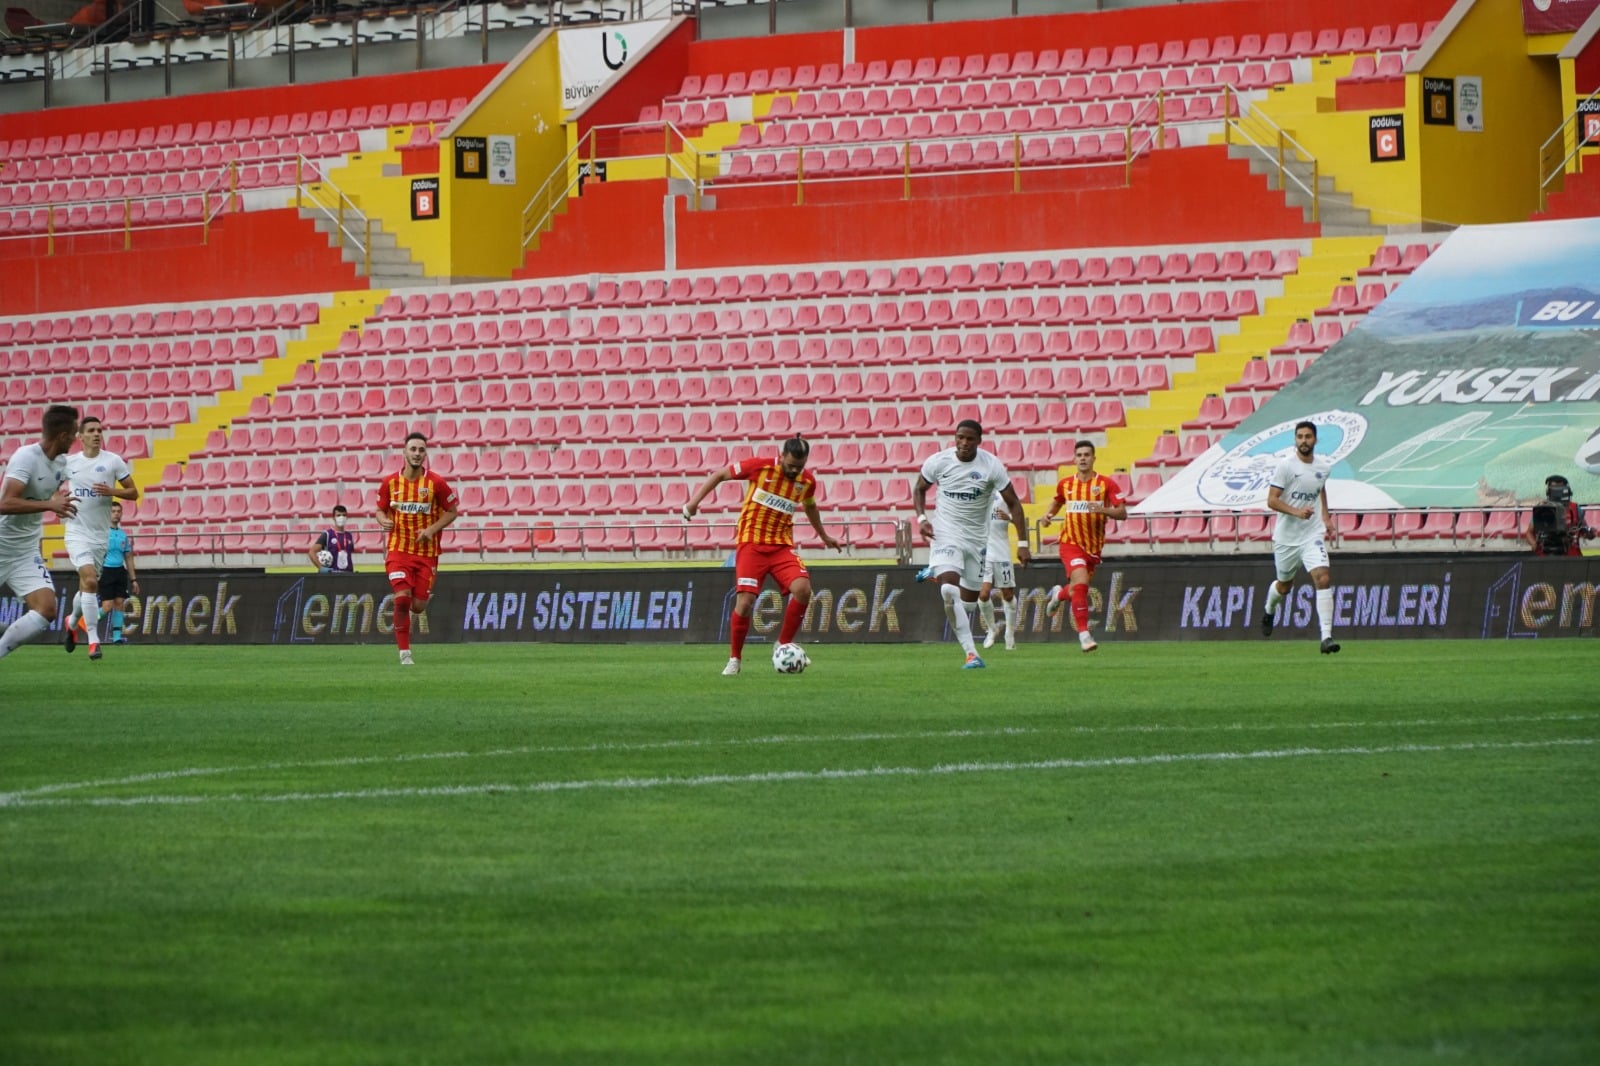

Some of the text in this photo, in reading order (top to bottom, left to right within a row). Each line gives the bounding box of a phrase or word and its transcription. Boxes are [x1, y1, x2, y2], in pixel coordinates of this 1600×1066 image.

[1380, 134, 1393, 153] C
[419, 195, 429, 212] B
[1530, 300, 1595, 321] BU
[302, 593, 433, 634] eme
[463, 582, 693, 631] KAPI SİSTEMLERİ
[1181, 586, 1254, 628] KAPI
